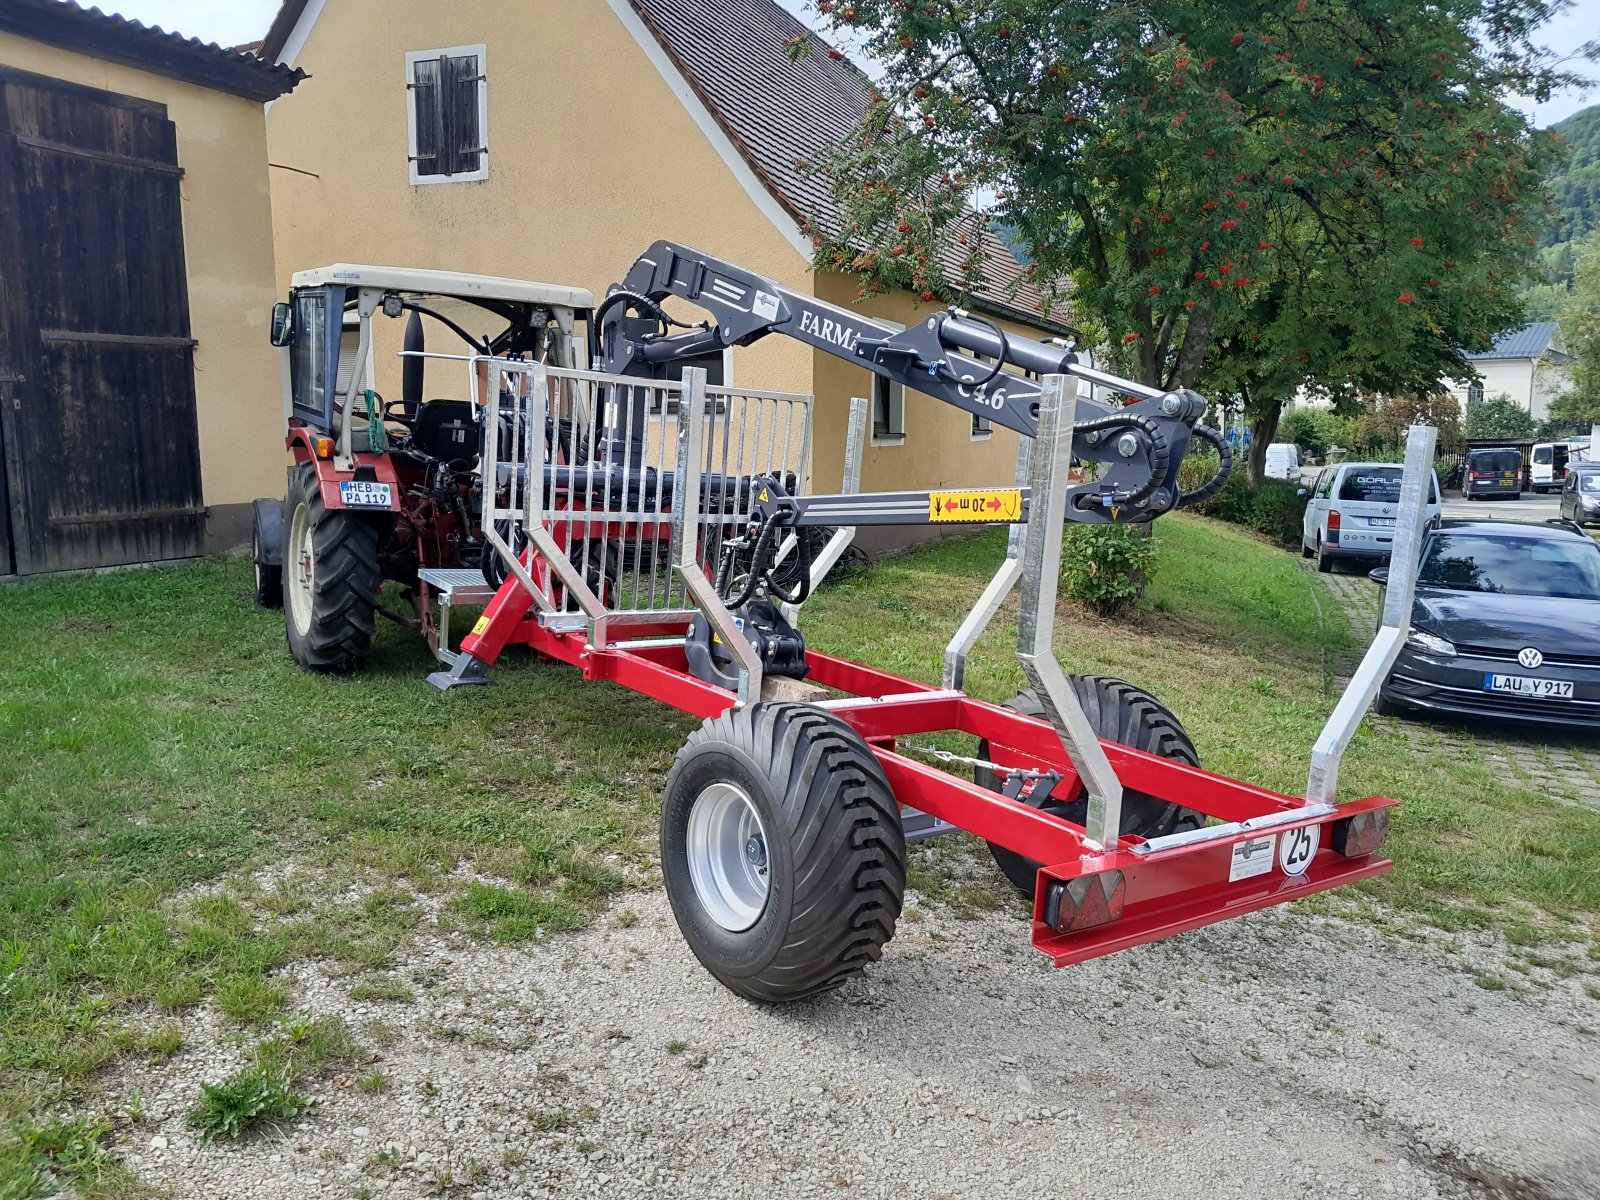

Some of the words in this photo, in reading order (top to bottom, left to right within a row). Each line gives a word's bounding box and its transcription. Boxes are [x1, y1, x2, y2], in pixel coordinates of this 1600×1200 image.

[349, 482, 373, 493] HEB
[346, 492, 361, 503] PA
[365, 494, 387, 504] 119
[960, 498, 970, 509] m
[972, 498, 985, 512] 20
[1493, 676, 1523, 691] LAU
[1532, 680, 1542, 692] Y
[1544, 682, 1572, 696] 917
[1286, 826, 1310, 866] 25
